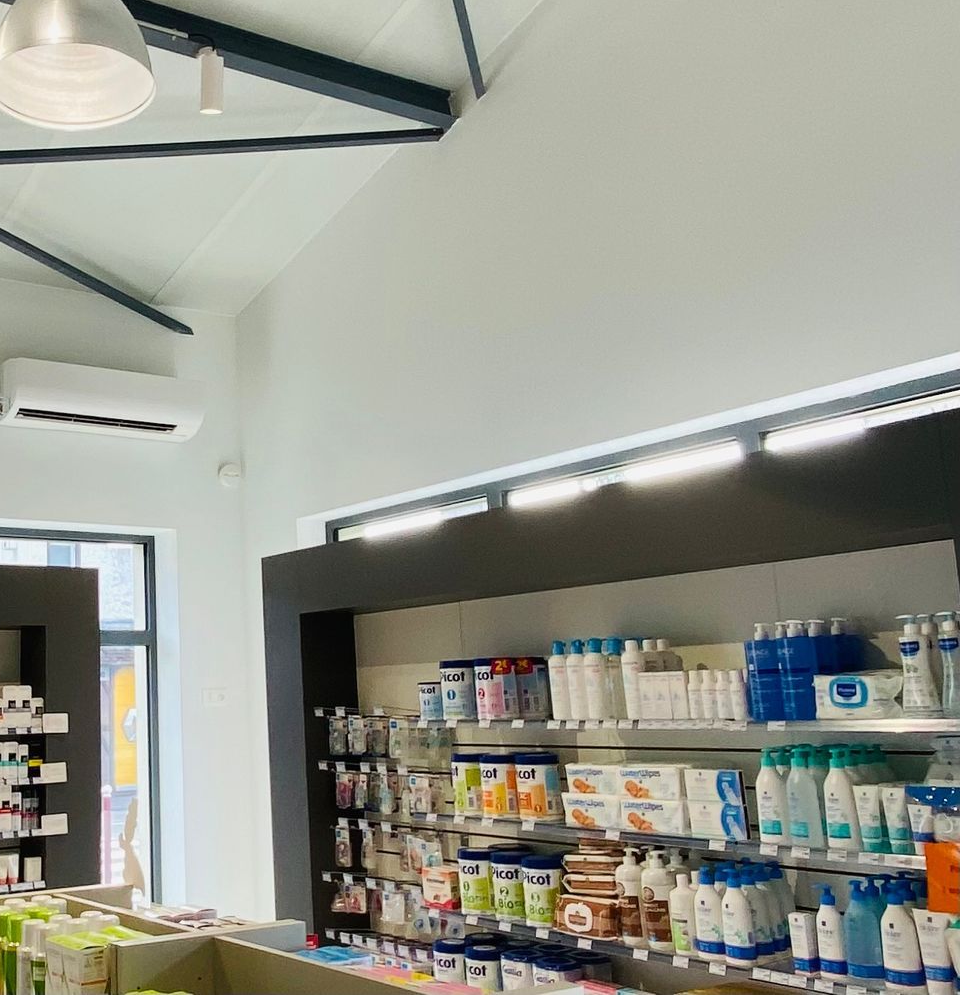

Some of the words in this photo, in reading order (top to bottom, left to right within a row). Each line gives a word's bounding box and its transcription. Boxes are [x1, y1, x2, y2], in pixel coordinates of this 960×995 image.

[477, 671, 494, 681] cot
[421, 686, 436, 695] icot
[483, 767, 498, 779] cot
[519, 768, 537, 780] cot
[462, 864, 480, 875] cot
[436, 957, 456, 969] icot
[469, 965, 487, 976] cot
